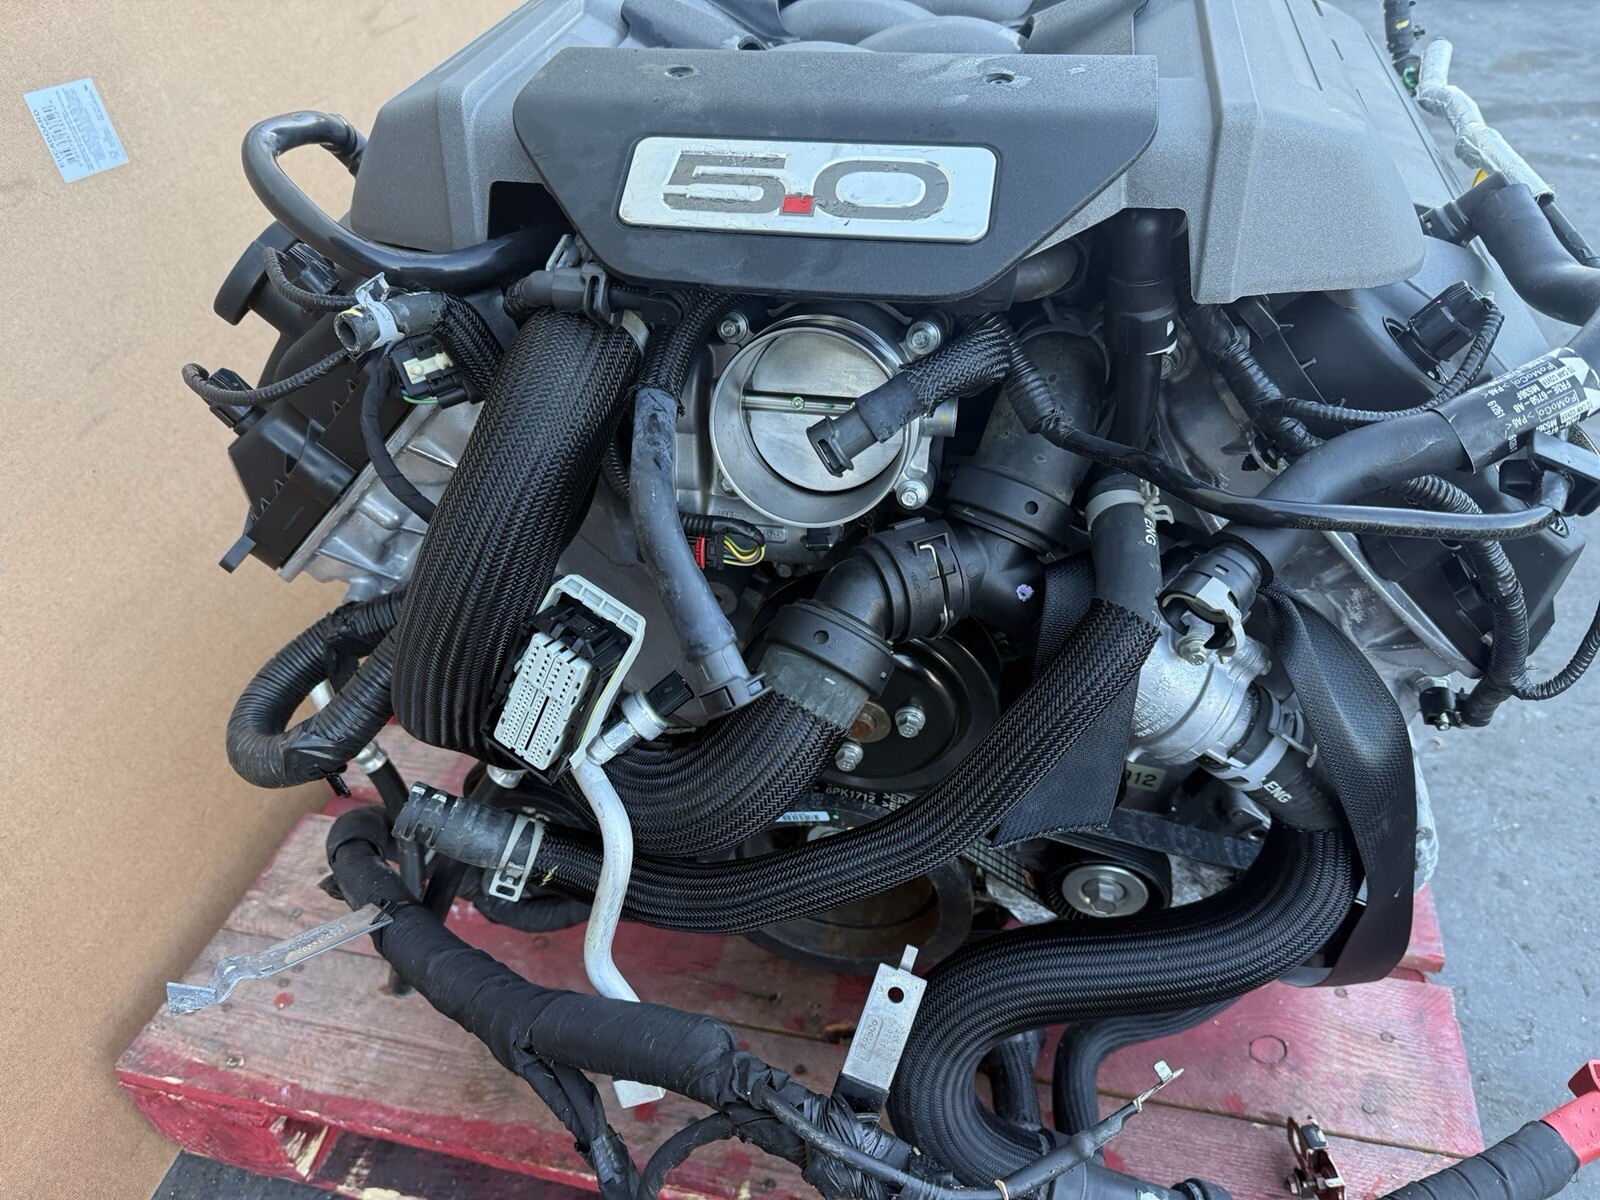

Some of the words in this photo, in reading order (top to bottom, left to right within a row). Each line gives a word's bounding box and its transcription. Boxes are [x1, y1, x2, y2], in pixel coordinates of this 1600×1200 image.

[661, 150, 951, 222] 5.0
[1513, 361, 1556, 386] FoMoCo
[1538, 392, 1578, 416] FoMoCo
[1143, 517, 1156, 546] ENG
[825, 786, 876, 804] 6PK1712
[1263, 780, 1293, 804] ENG
